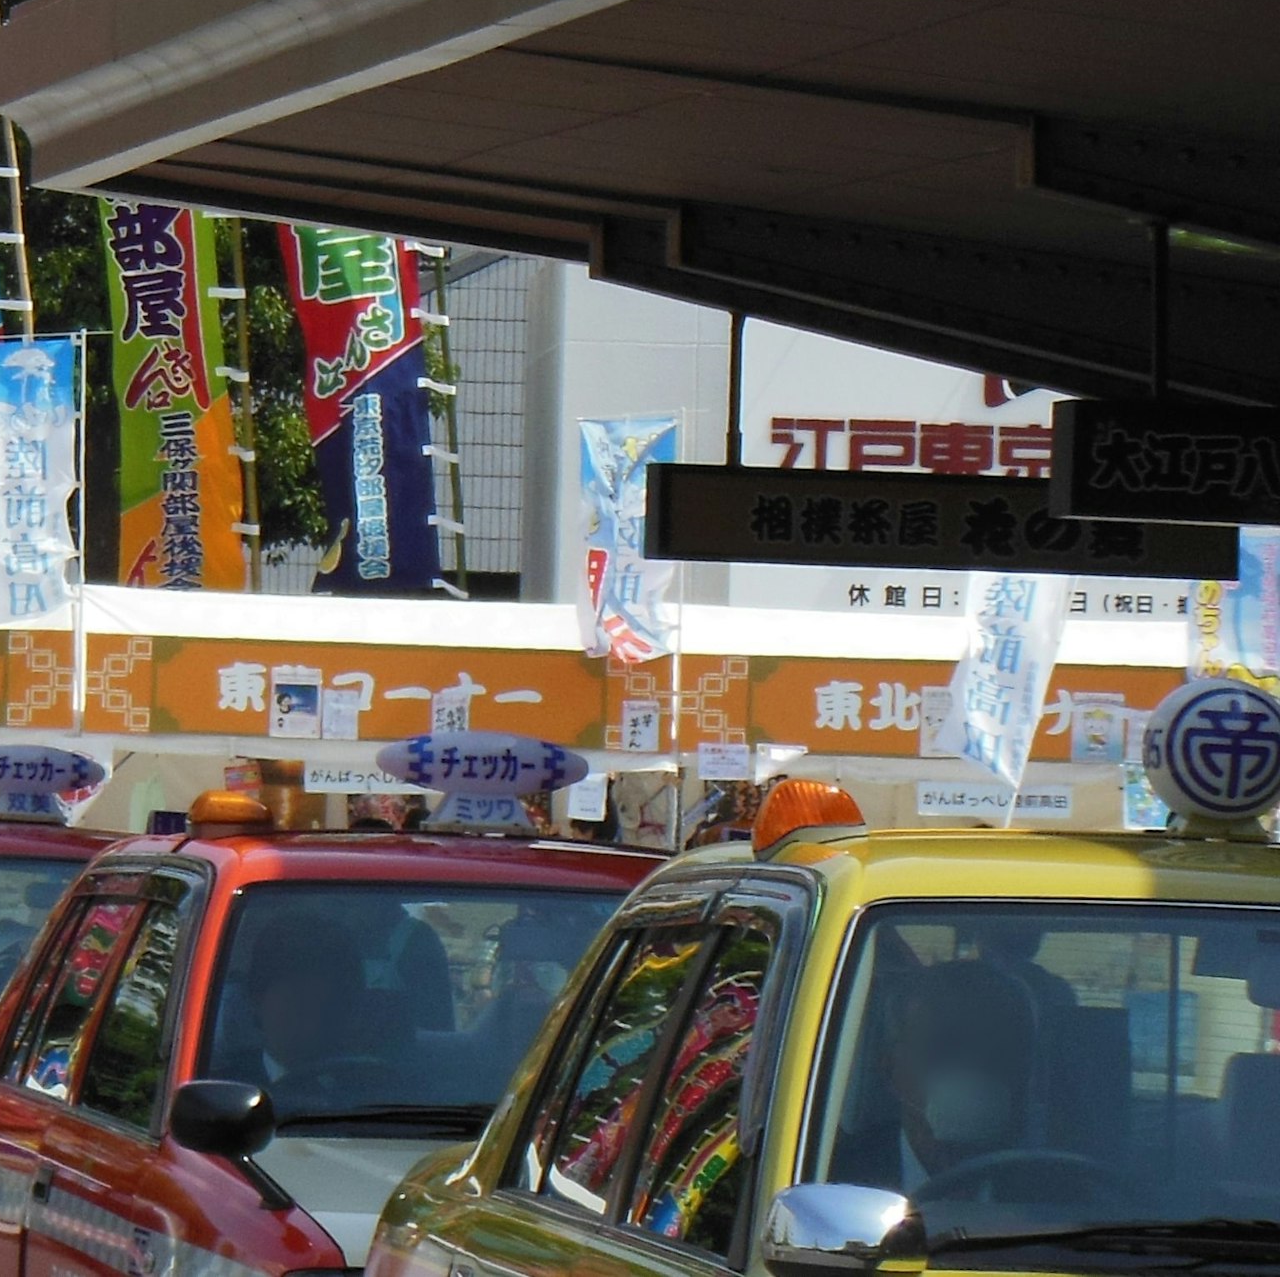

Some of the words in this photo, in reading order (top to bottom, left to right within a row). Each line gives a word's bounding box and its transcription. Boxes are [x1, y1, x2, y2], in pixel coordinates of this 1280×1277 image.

[771, 417, 1052, 475] 江戸東京
[218, 662, 542, 713] 東コーナー
[441, 747, 535, 781] チェッカー
[456, 798, 514, 820] ミツワ
